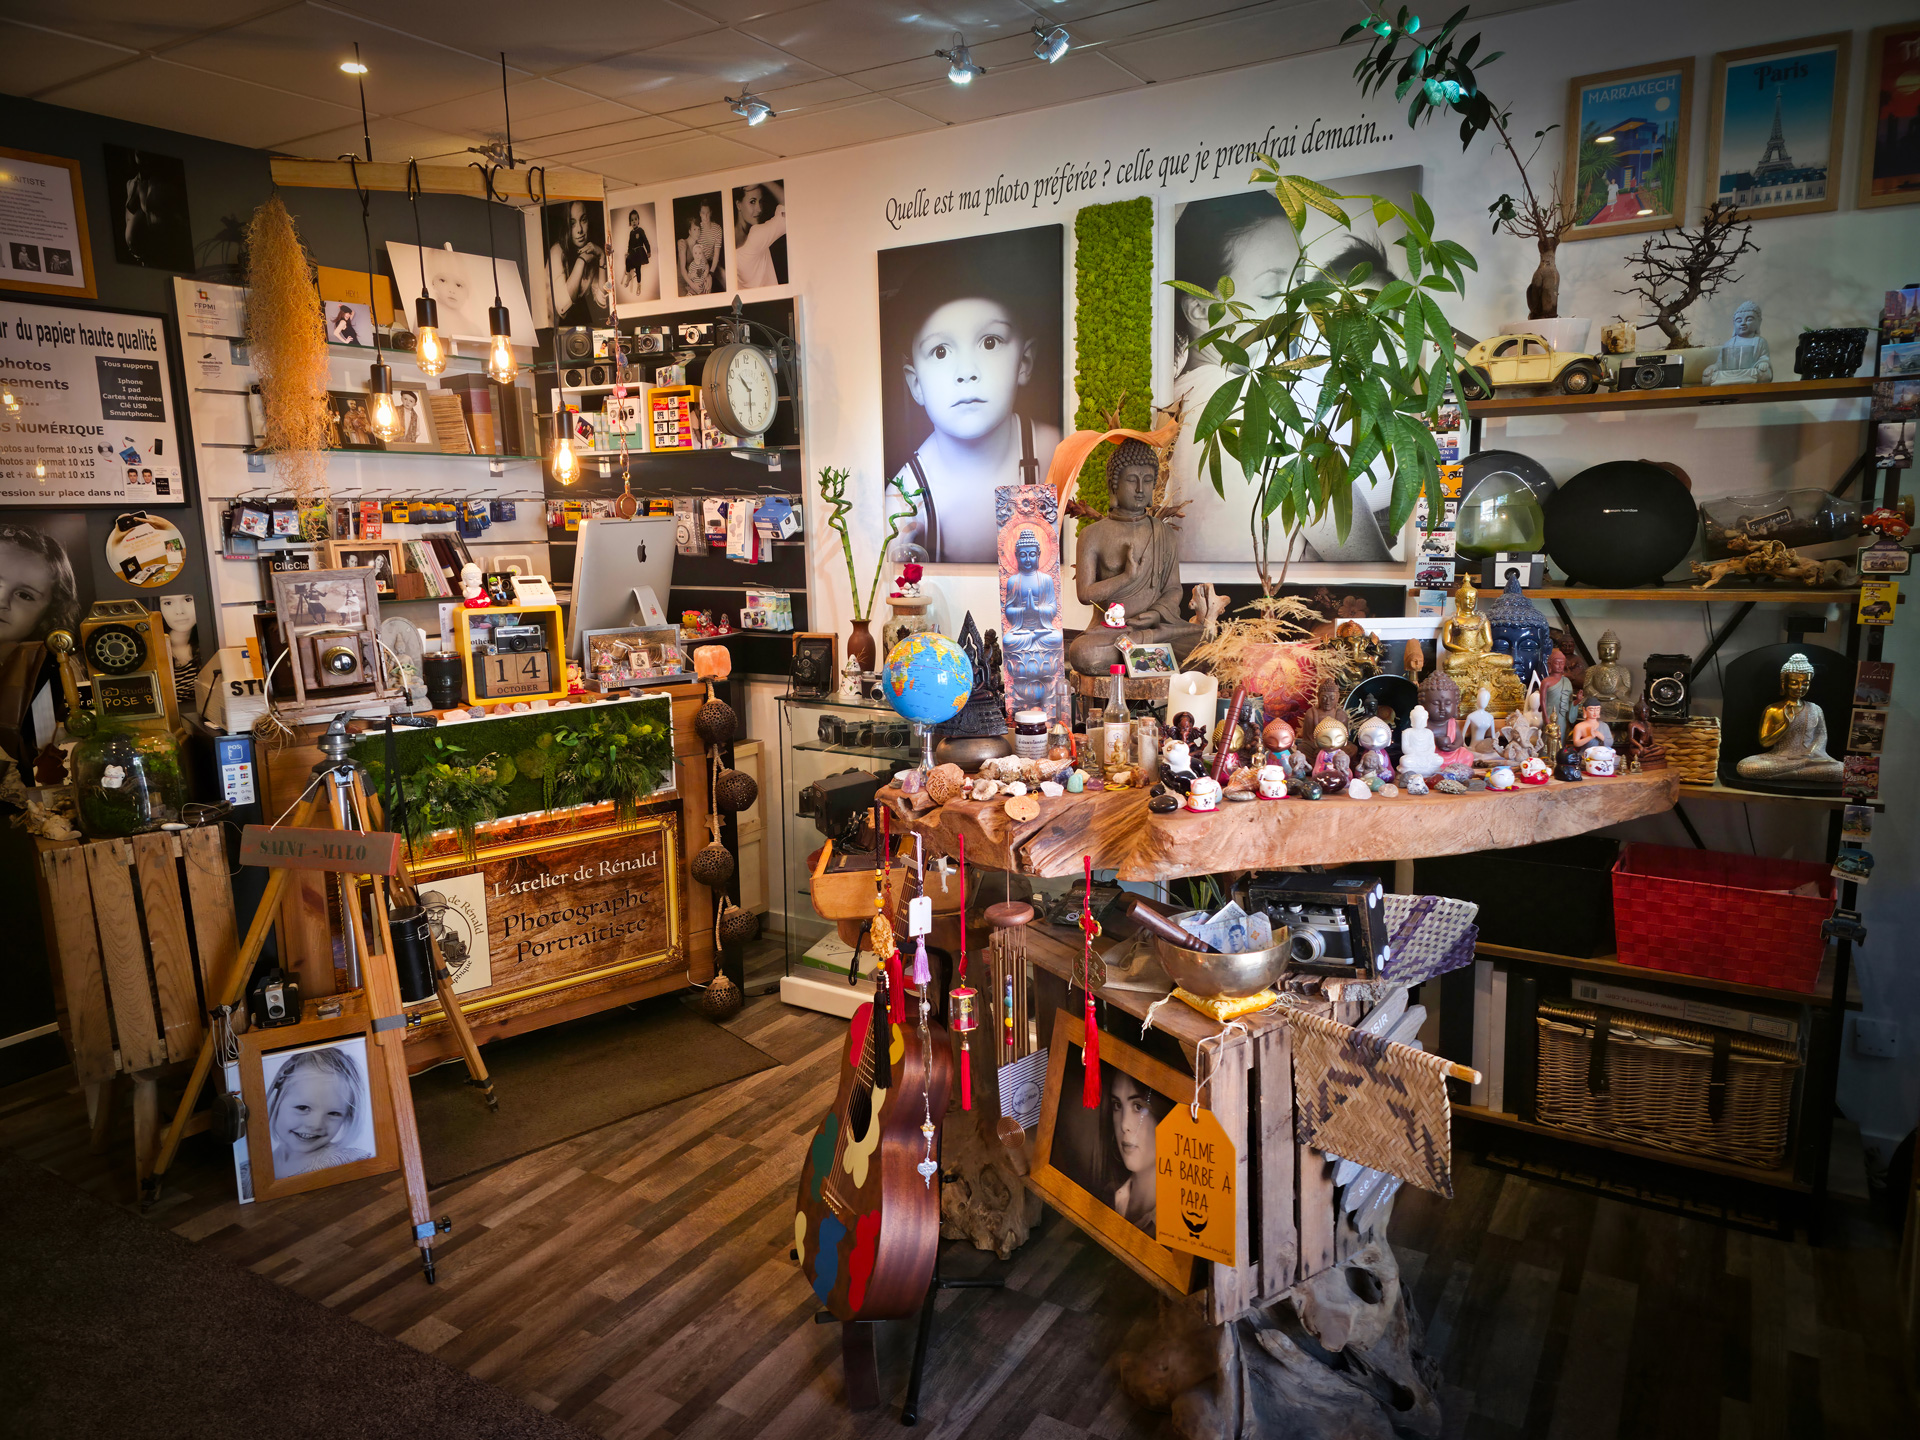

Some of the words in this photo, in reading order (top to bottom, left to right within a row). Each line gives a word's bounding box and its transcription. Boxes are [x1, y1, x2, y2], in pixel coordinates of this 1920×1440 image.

[1754, 60, 1809, 91] Paris
[1587, 77, 1676, 105] MARRAKECH
[885, 188, 929, 231] Quelle
[933, 190, 954, 215] est
[958, 189, 980, 211] ma
[983, 174, 1029, 216] photo
[1032, 161, 1097, 208] préférée
[1102, 159, 1112, 187] ?
[1116, 147, 1154, 185] celle
[1158, 152, 1190, 188] que
[1190, 141, 1210, 184] je
[1213, 125, 1299, 179] prendrai
[1301, 113, 1394, 155] demain...
[16, 317, 33, 341] du
[36, 321, 76, 348] papier
[79, 323, 114, 347] haute
[117, 328, 157, 354] qualité
[103, 360, 121, 368] Tous
[117, 377, 143, 385] Iphone
[128, 394, 162, 402] mémoires
[16, 421, 105, 436] NUMÉRIQUE
[36, 445, 64, 454] format
[67, 446, 76, 454] 10
[78, 446, 94, 454] x15
[68, 458, 78, 466] 10
[80, 458, 95, 467] x15
[6, 470, 15, 479] et
[68, 470, 78, 479] 10
[80, 471, 95, 479] x15
[58, 489, 85, 498] place
[88, 489, 111, 497] dans
[120, 687, 152, 696] Studio
[497, 684, 539, 694] OCTOBER
[103, 696, 140, 708] POSE
[492, 873, 568, 899] L'atelier
[573, 865, 594, 882] de
[598, 851, 657, 877] Rénald
[448, 895, 461, 906] de
[460, 901, 484, 935] Rénald
[501, 888, 651, 942] Photographe
[514, 917, 648, 967] Portraitiste
[1174, 1133, 1216, 1164] J'AIME
[1158, 1156, 1173, 1177] LA
[1179, 1160, 1215, 1189] BARBE
[1221, 1171, 1232, 1195] À
[1180, 1188, 1209, 1213] PAPA
